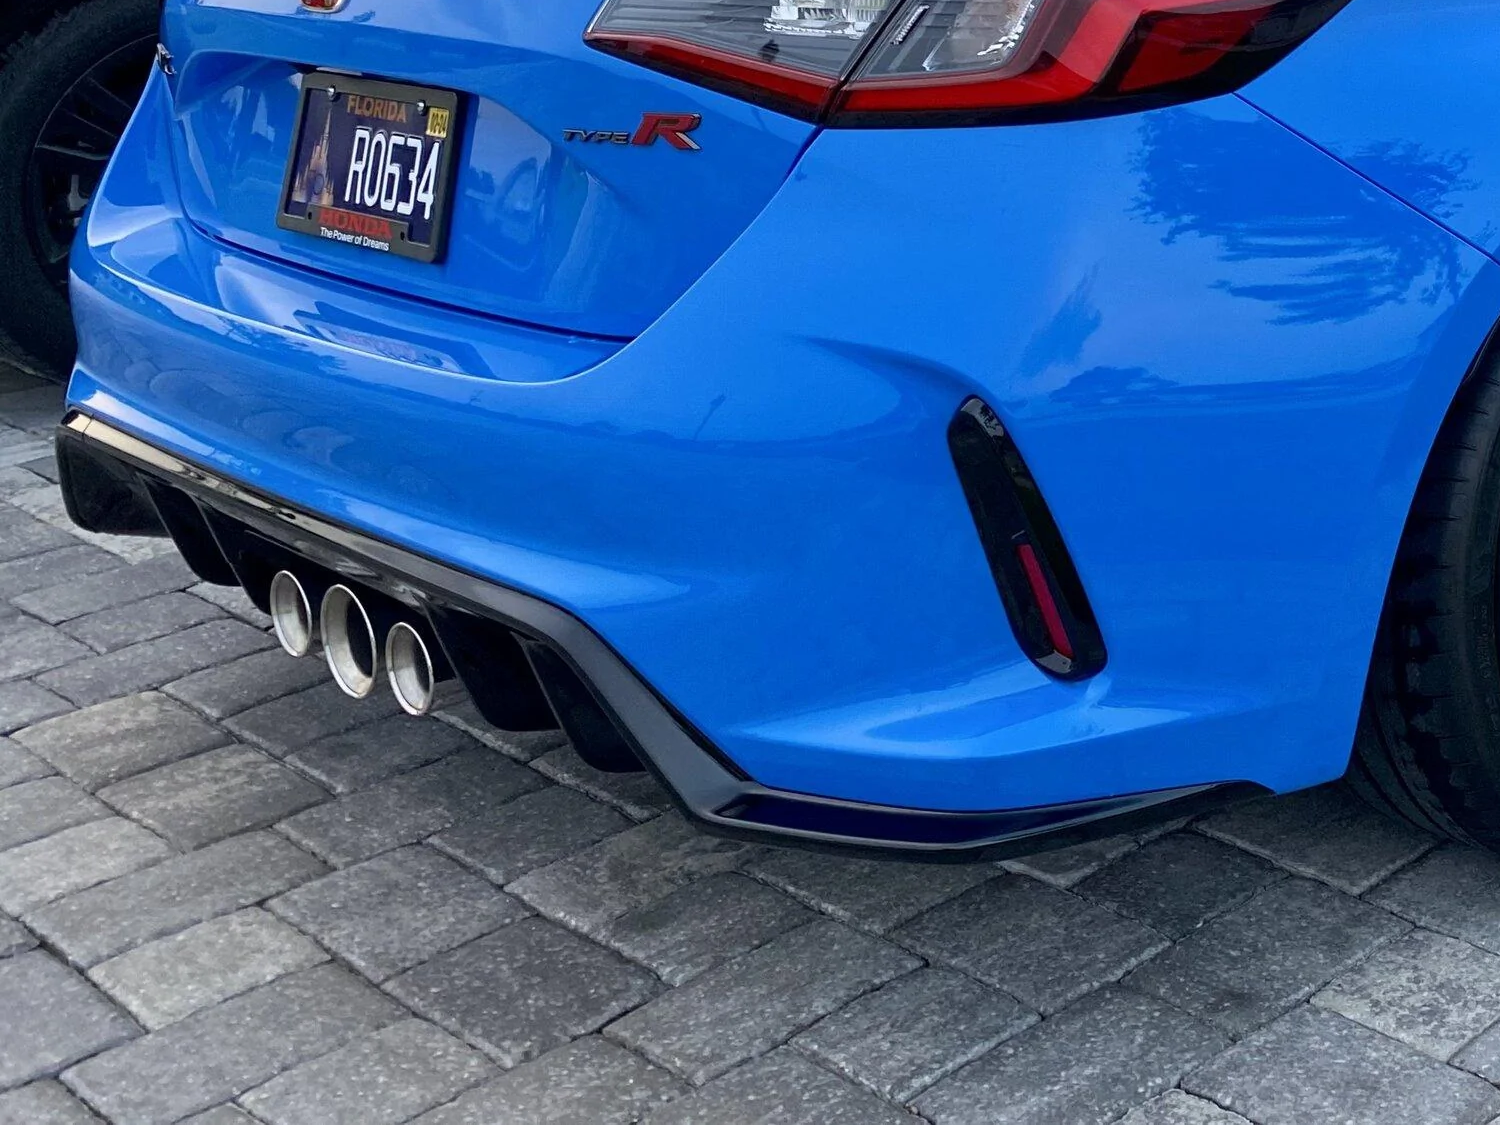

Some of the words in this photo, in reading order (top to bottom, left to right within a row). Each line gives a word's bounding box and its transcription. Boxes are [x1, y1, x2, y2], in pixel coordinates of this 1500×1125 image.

[347, 95, 408, 123] FLORIDA
[563, 129, 631, 145] TYPE
[631, 112, 702, 150] R
[319, 208, 392, 239] HONDA
[320, 227, 332, 238] The
[333, 230, 353, 243] Power
[354, 235, 362, 245] of
[363, 237, 389, 251] Dreams
